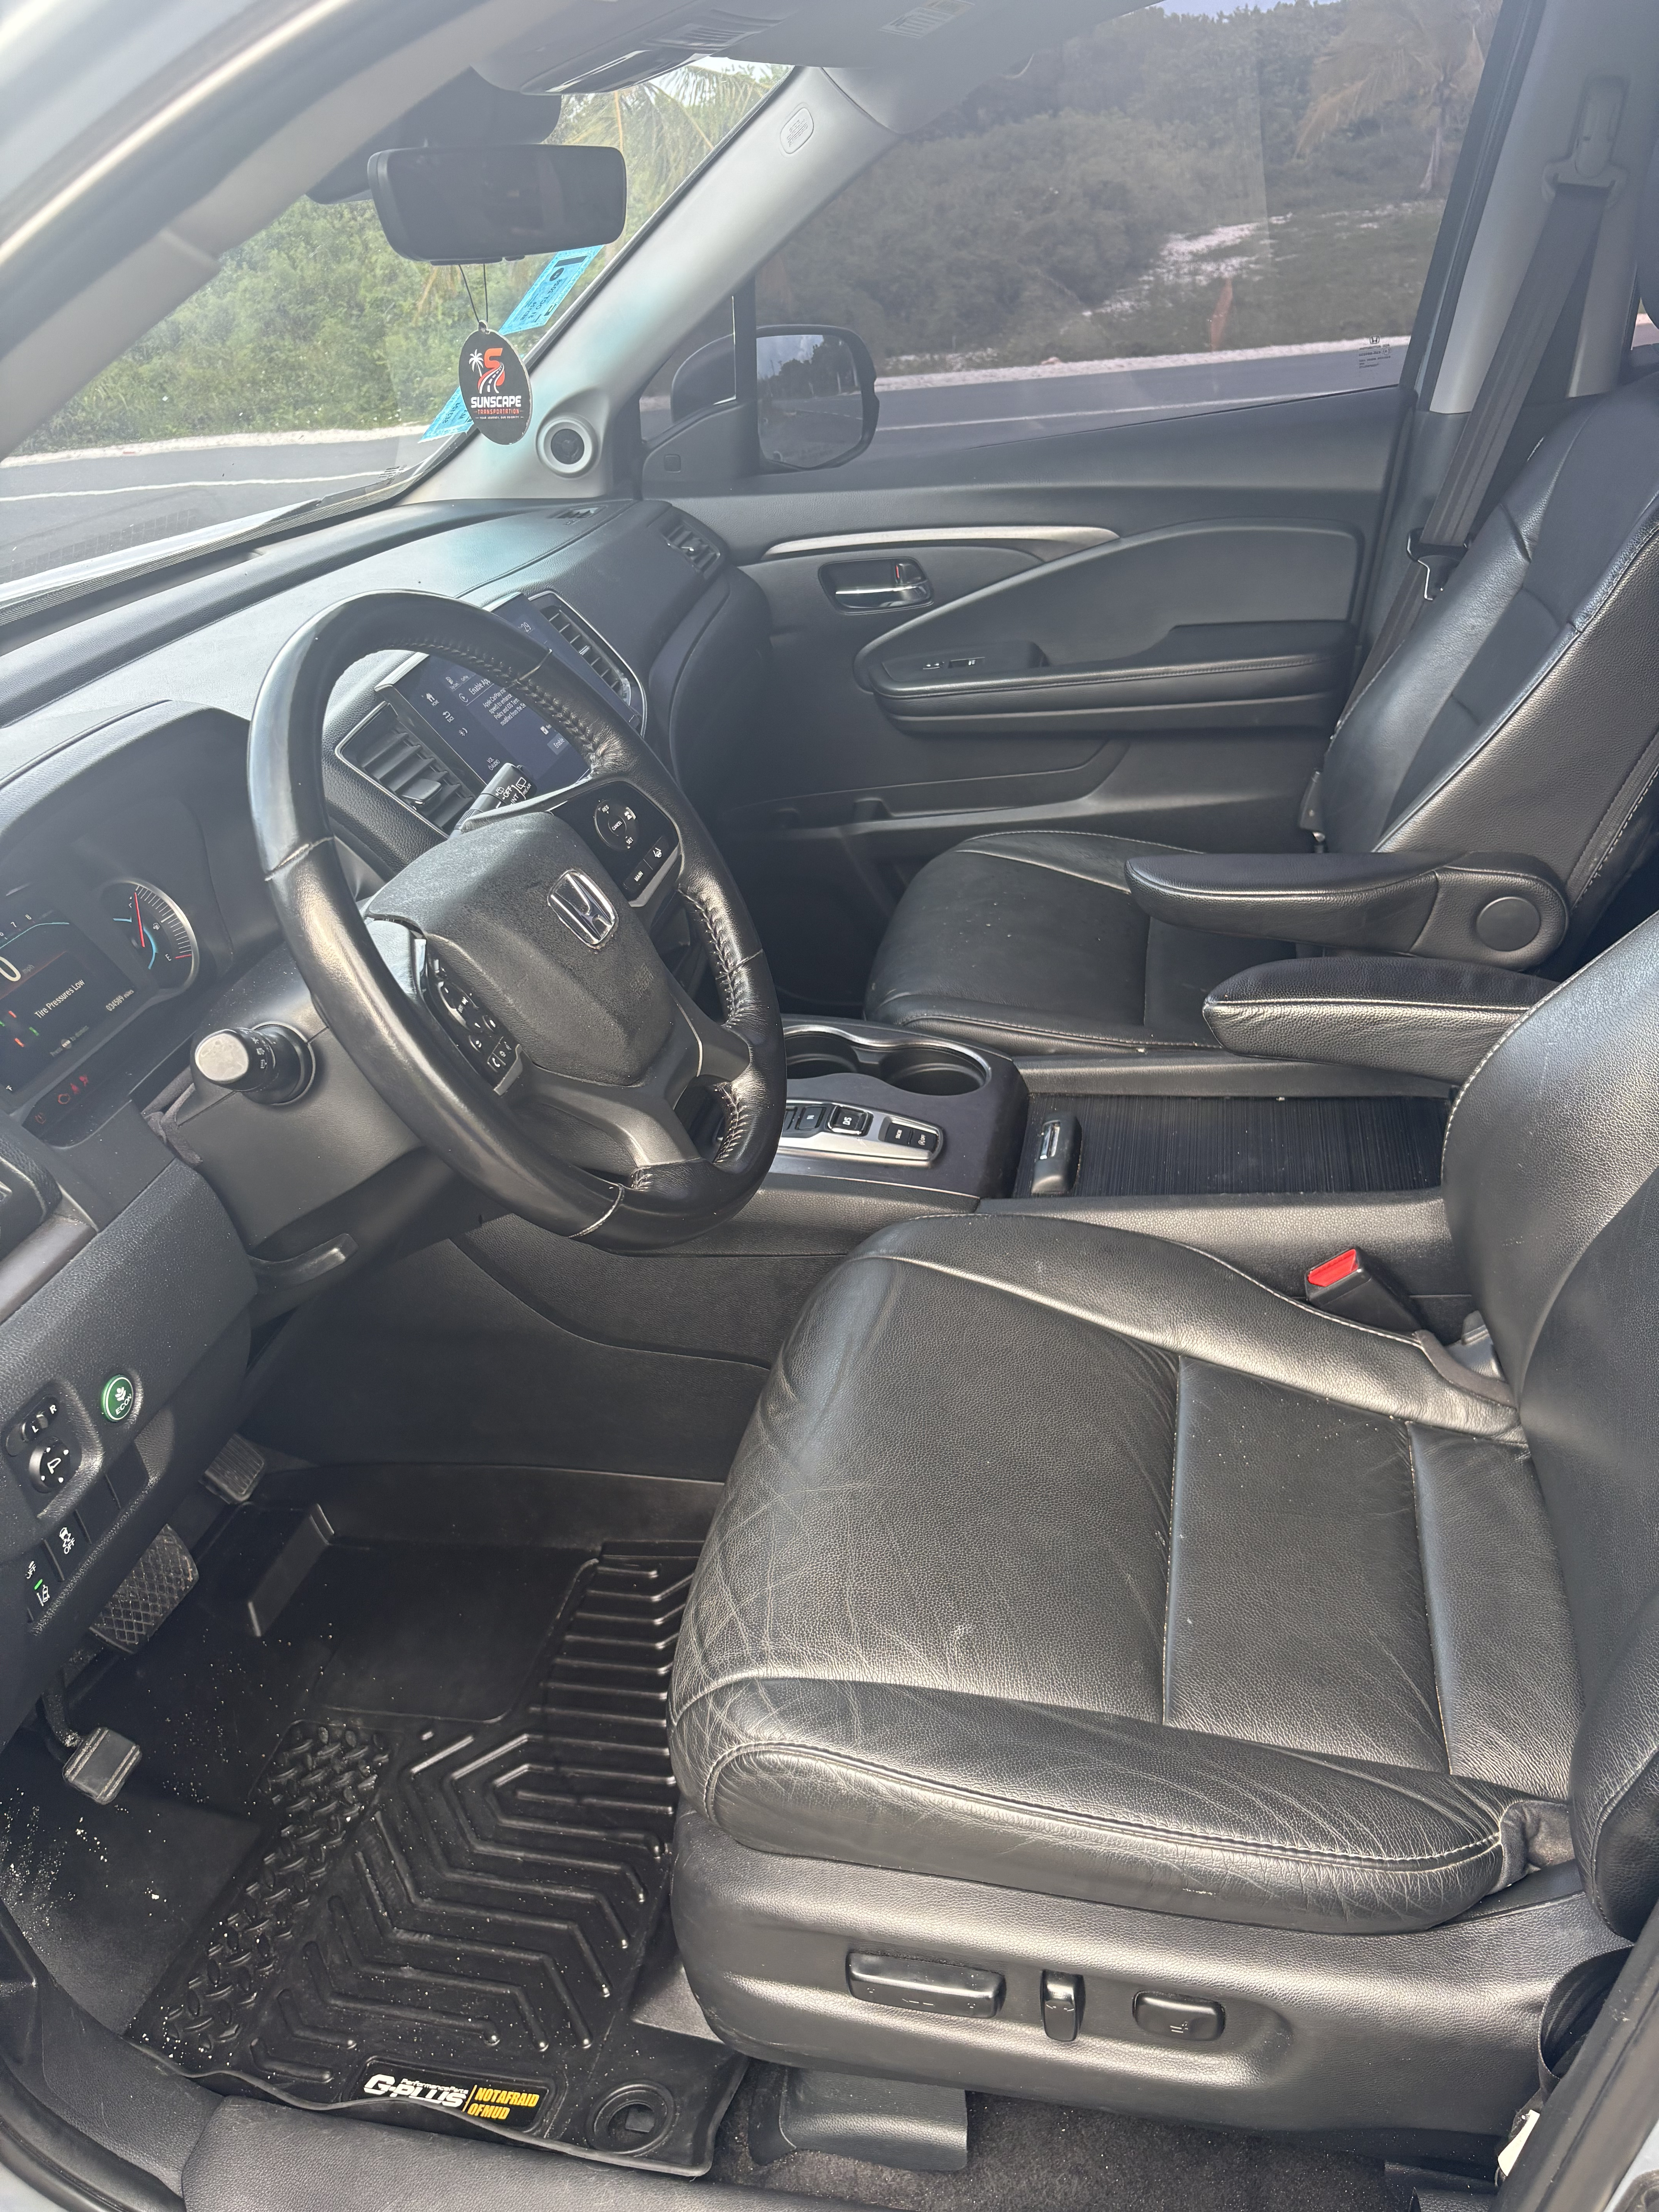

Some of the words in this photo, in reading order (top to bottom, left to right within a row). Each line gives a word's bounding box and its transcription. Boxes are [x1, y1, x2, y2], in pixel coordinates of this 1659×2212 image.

[471, 395, 522, 408] SUNSCAPE
[469, 682, 484, 695] Enable
[483, 699, 493, 708] Apple
[494, 711, 505, 720] Policy
[510, 709, 519, 717] from
[491, 759, 500, 769] AUDIO
[503, 786, 512, 798] OFF
[522, 783, 532, 795] REAR
[510, 793, 519, 804] INT
[612, 821, 623, 831] CANCEL
[634, 871, 644, 882] MAIN
[22, 964, 35, 974] mph
[34, 1008, 49, 1018] Tire
[46, 987, 74, 1010] Pressures
[71, 979, 85, 991] Low
[105, 995, 124, 1012] 034589
[50, 1404, 57, 1414] R
[115, 1393, 132, 1415] ECON
[32, 1425, 39, 1433] L
[64, 1537, 76, 1554] OFF
